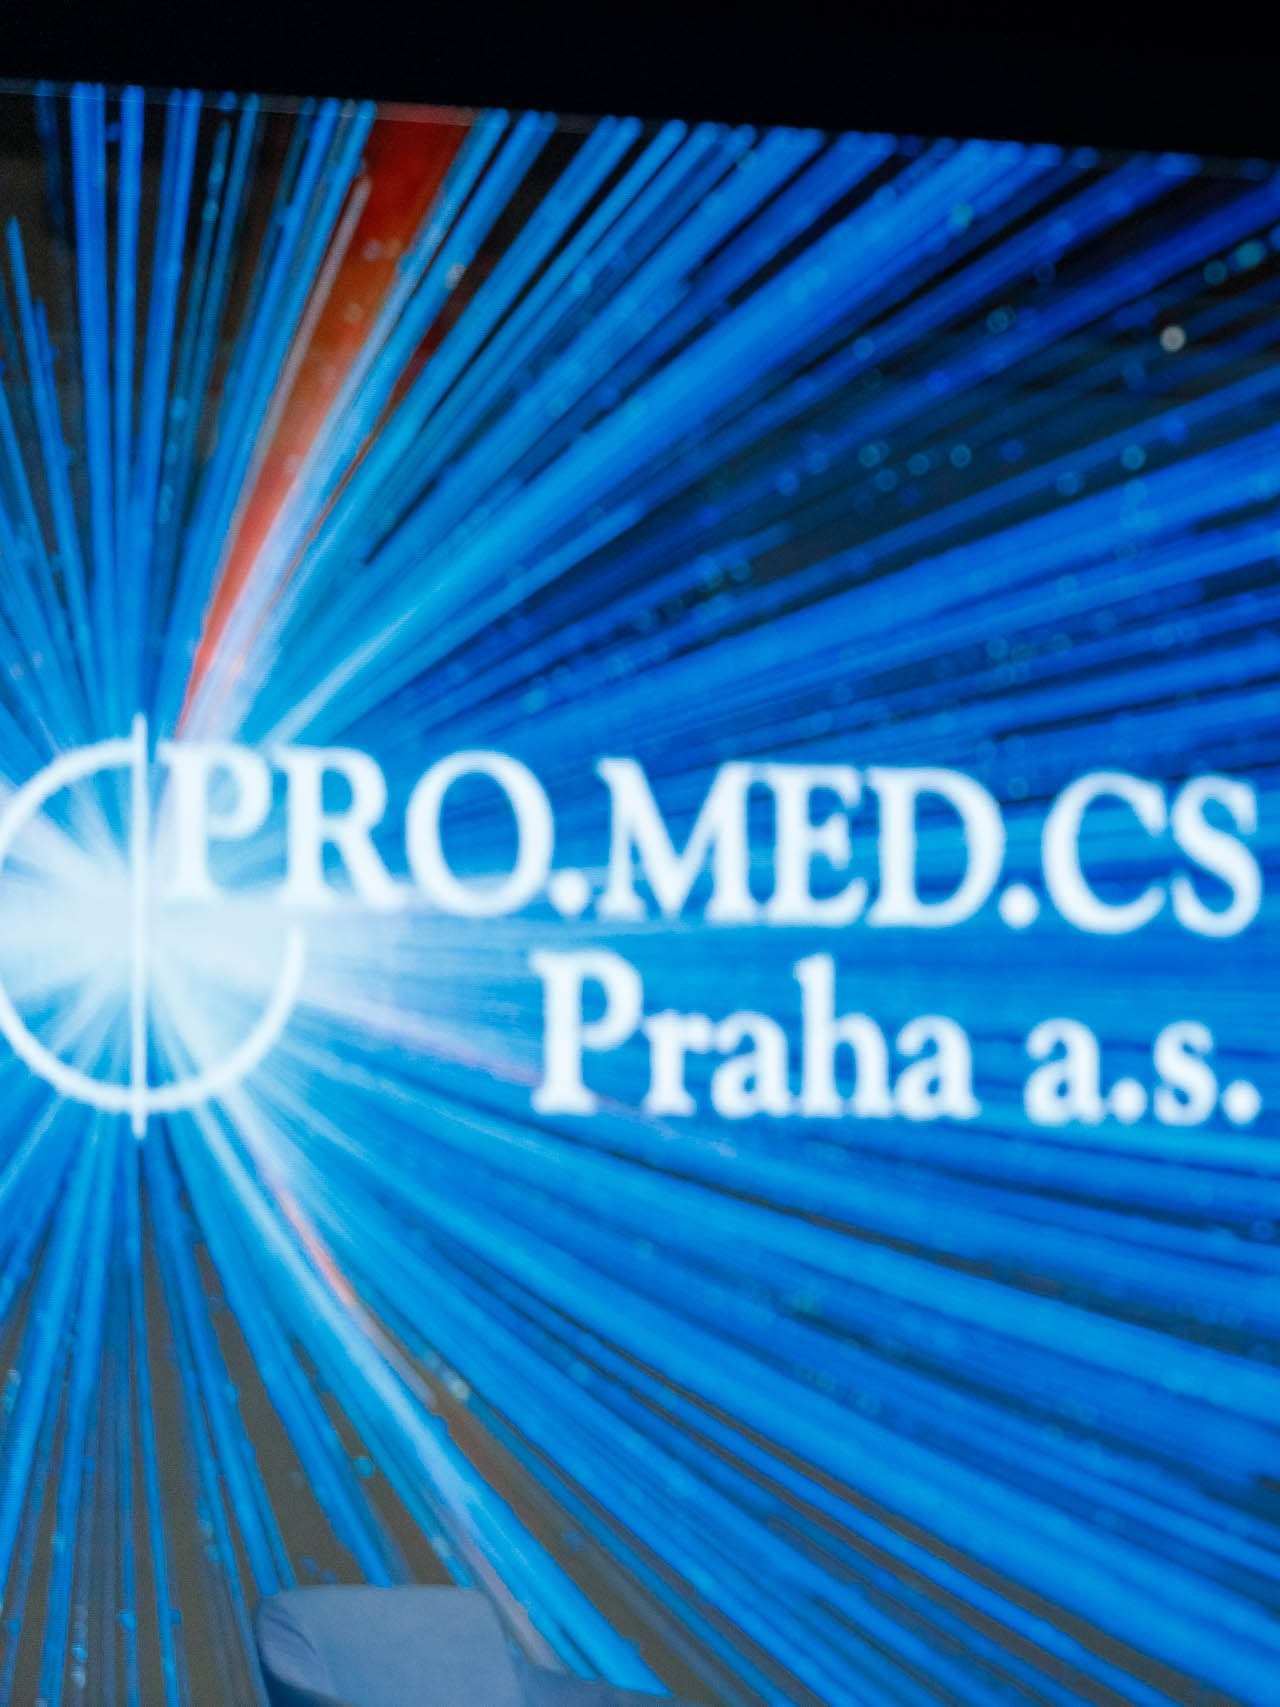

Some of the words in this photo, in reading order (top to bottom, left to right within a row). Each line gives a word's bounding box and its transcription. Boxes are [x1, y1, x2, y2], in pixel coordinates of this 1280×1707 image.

[158, 741, 1263, 937] PRO.MED.CS
[529, 948, 981, 1121] Praha
[1022, 1017, 1262, 1126] a.s.
